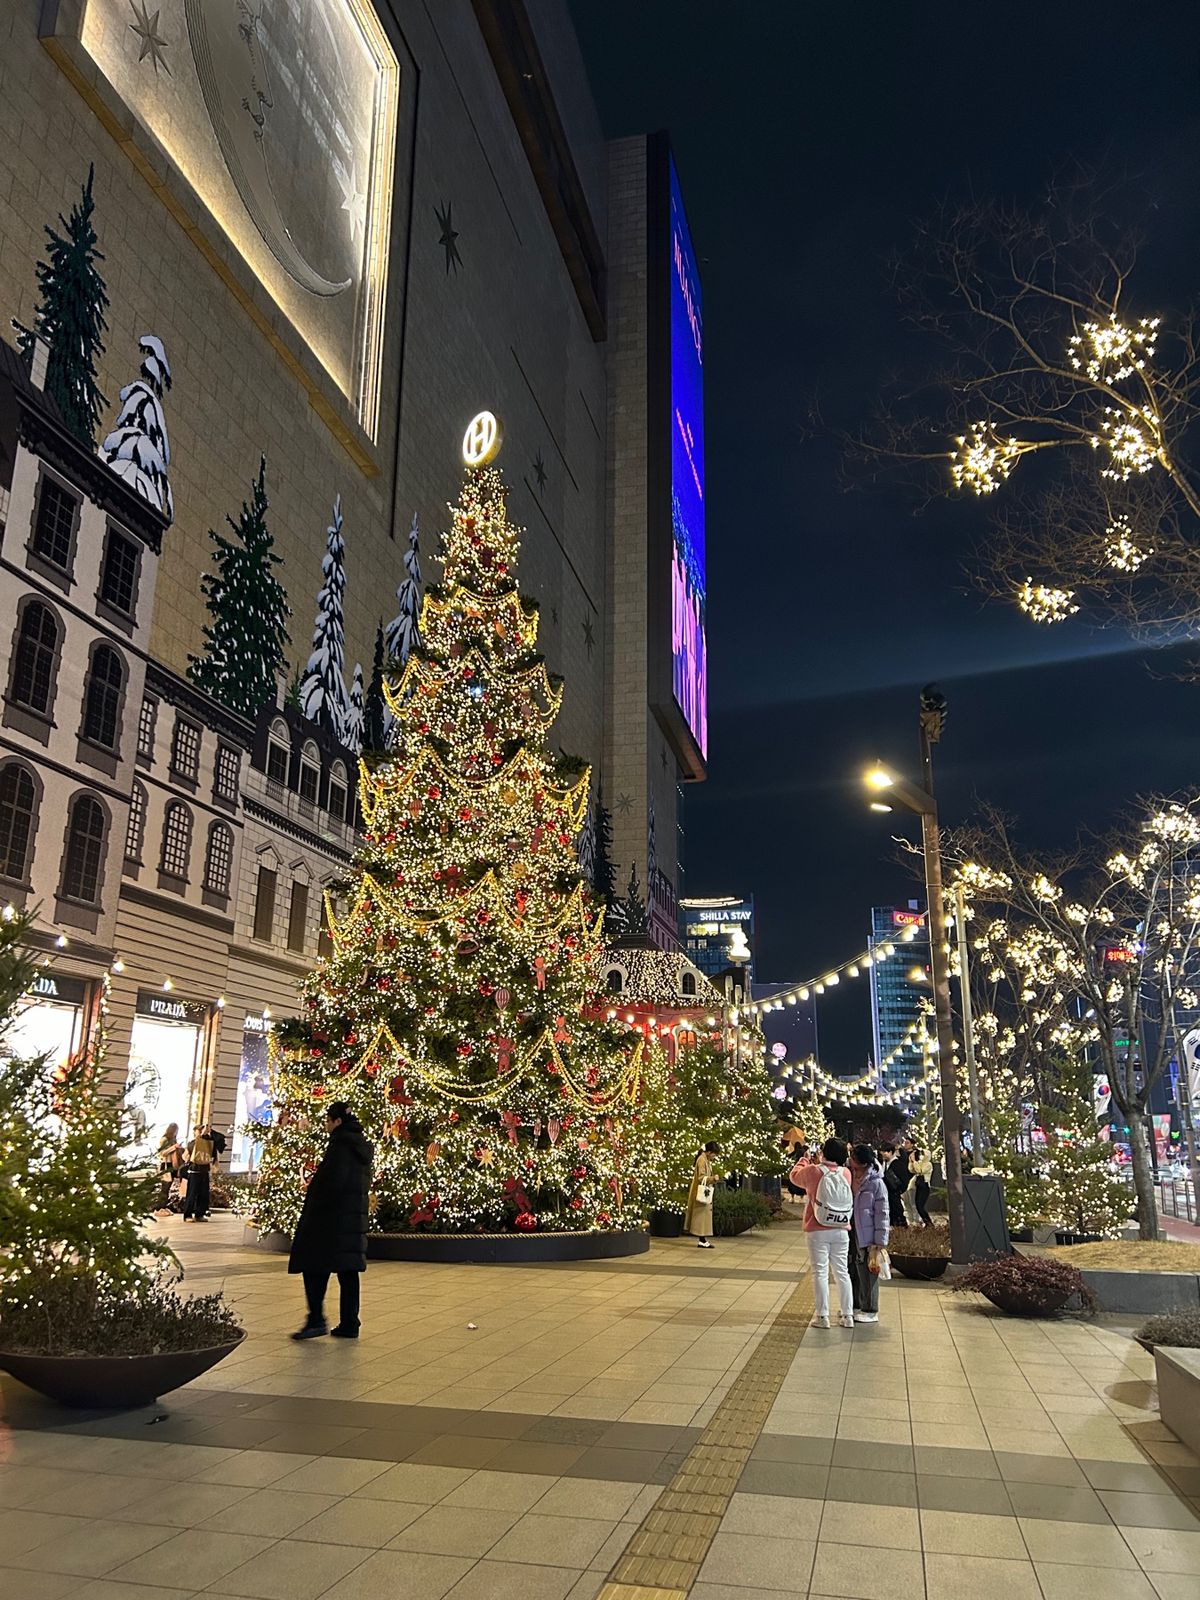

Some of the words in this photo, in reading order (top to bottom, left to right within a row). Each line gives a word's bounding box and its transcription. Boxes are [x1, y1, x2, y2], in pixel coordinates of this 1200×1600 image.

[700, 911, 729, 921] SHILLA
[730, 911, 752, 920] STAY
[896, 914, 925, 926] Canon
[150, 999, 187, 1017] PRADA
[826, 1213, 848, 1223] FILA
